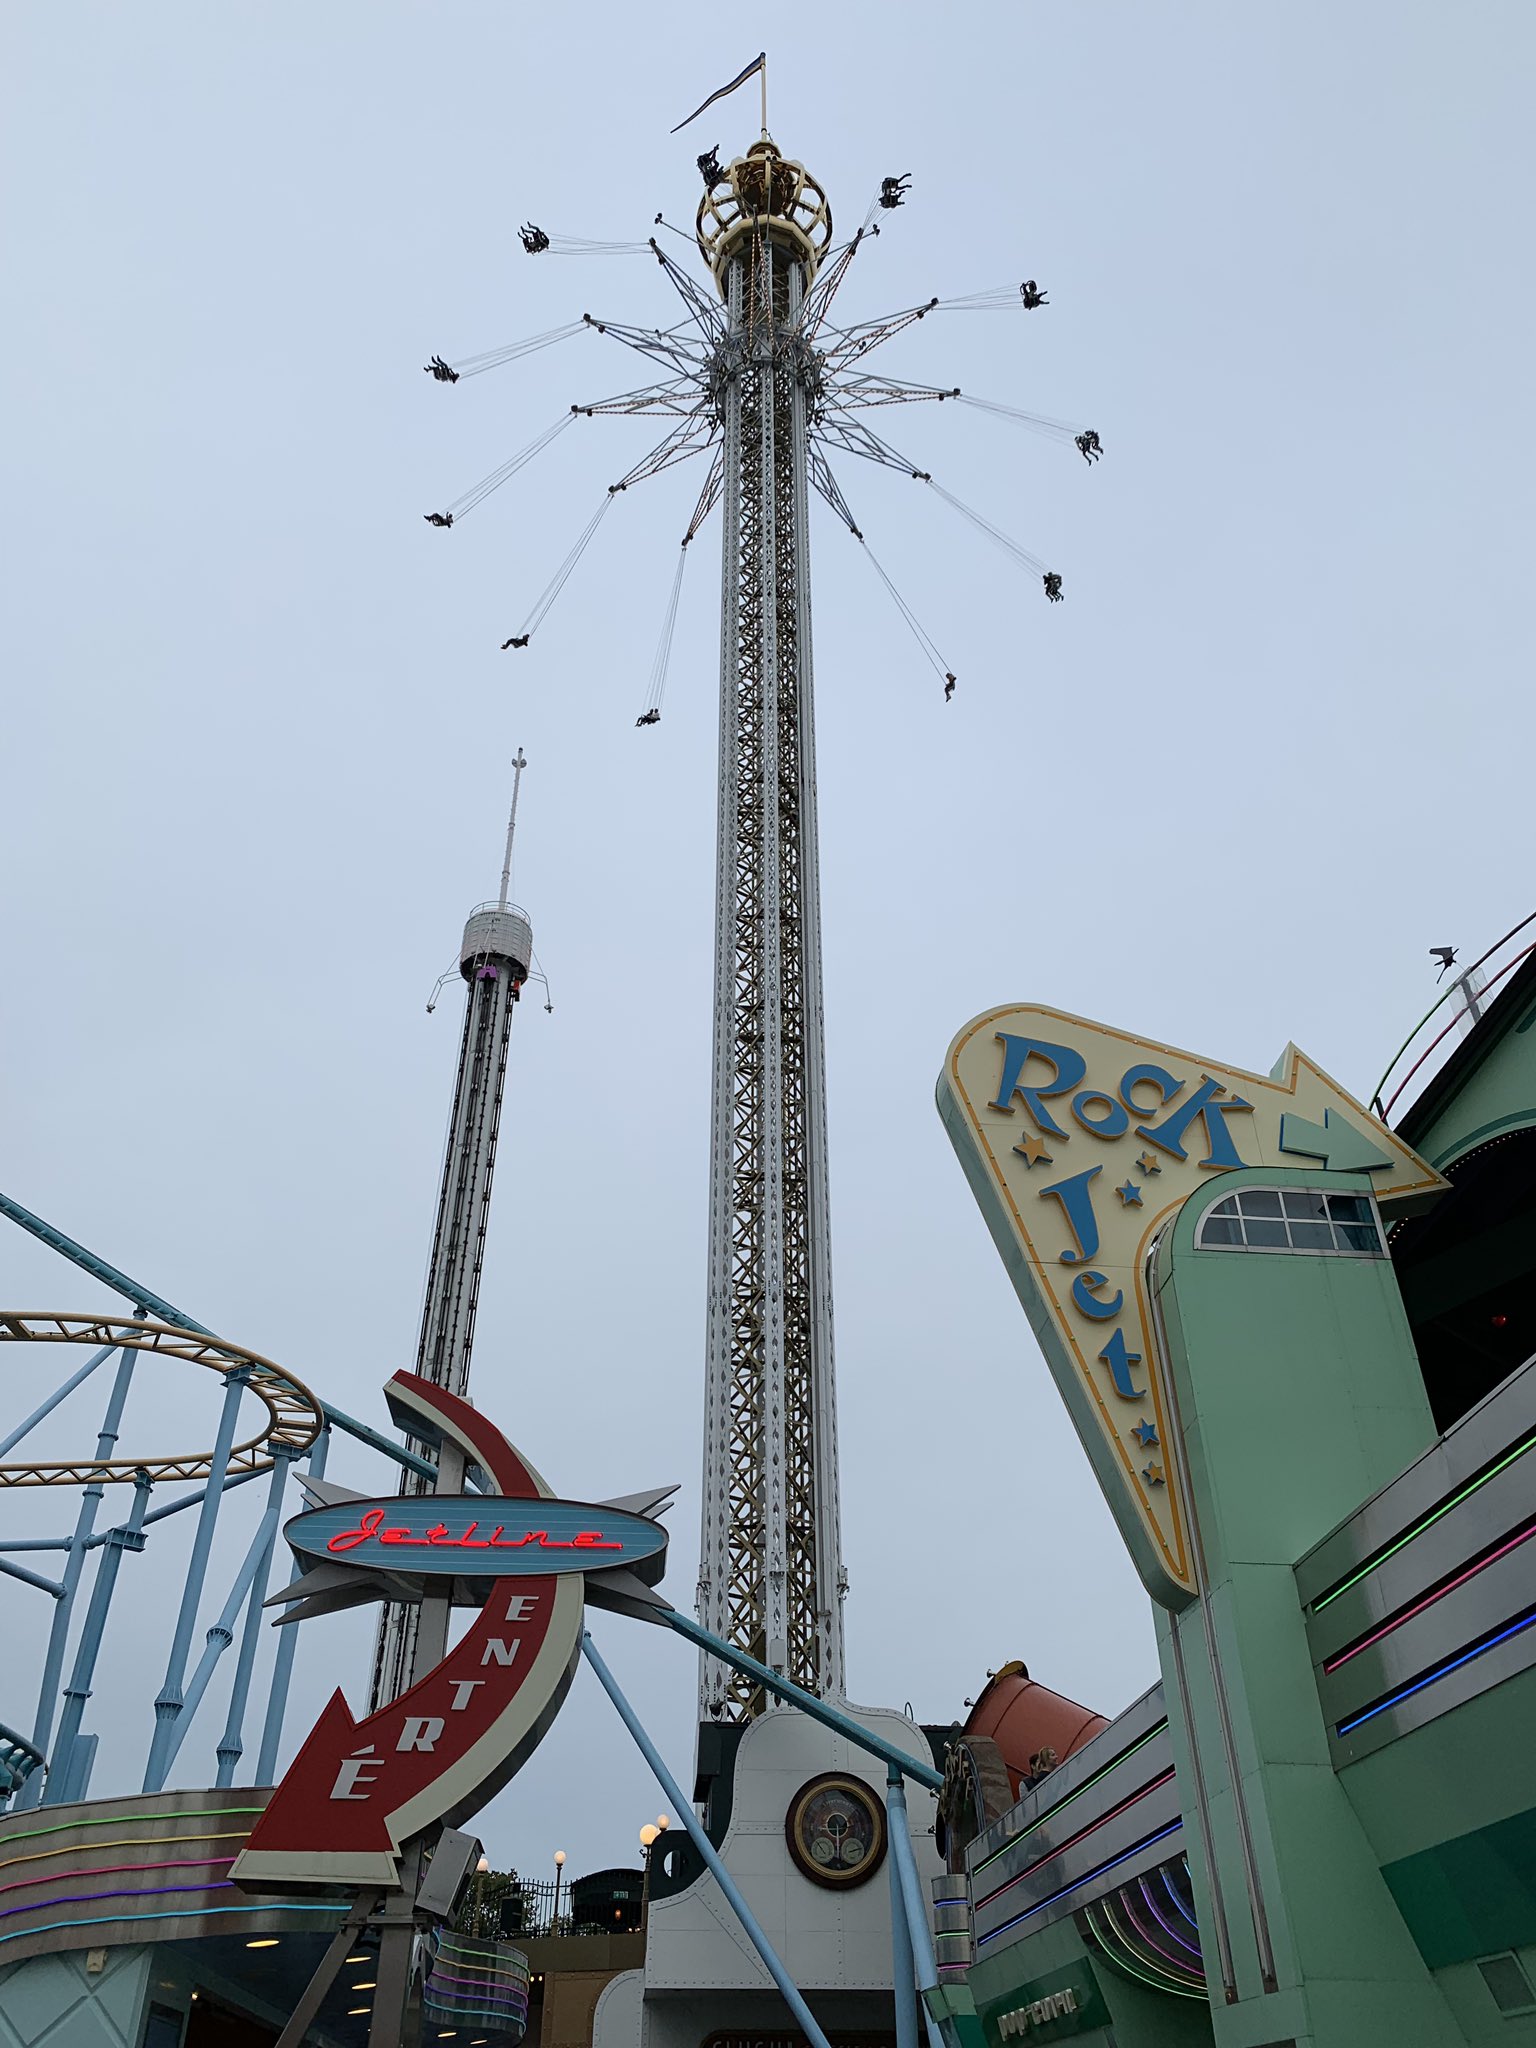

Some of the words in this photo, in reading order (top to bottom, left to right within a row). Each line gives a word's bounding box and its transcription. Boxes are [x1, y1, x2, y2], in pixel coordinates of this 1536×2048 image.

[1039, 1164, 1147, 1399] Jet
[327, 1508, 623, 1551] Jetline
[329, 1595, 540, 1800] ENTRÉ
